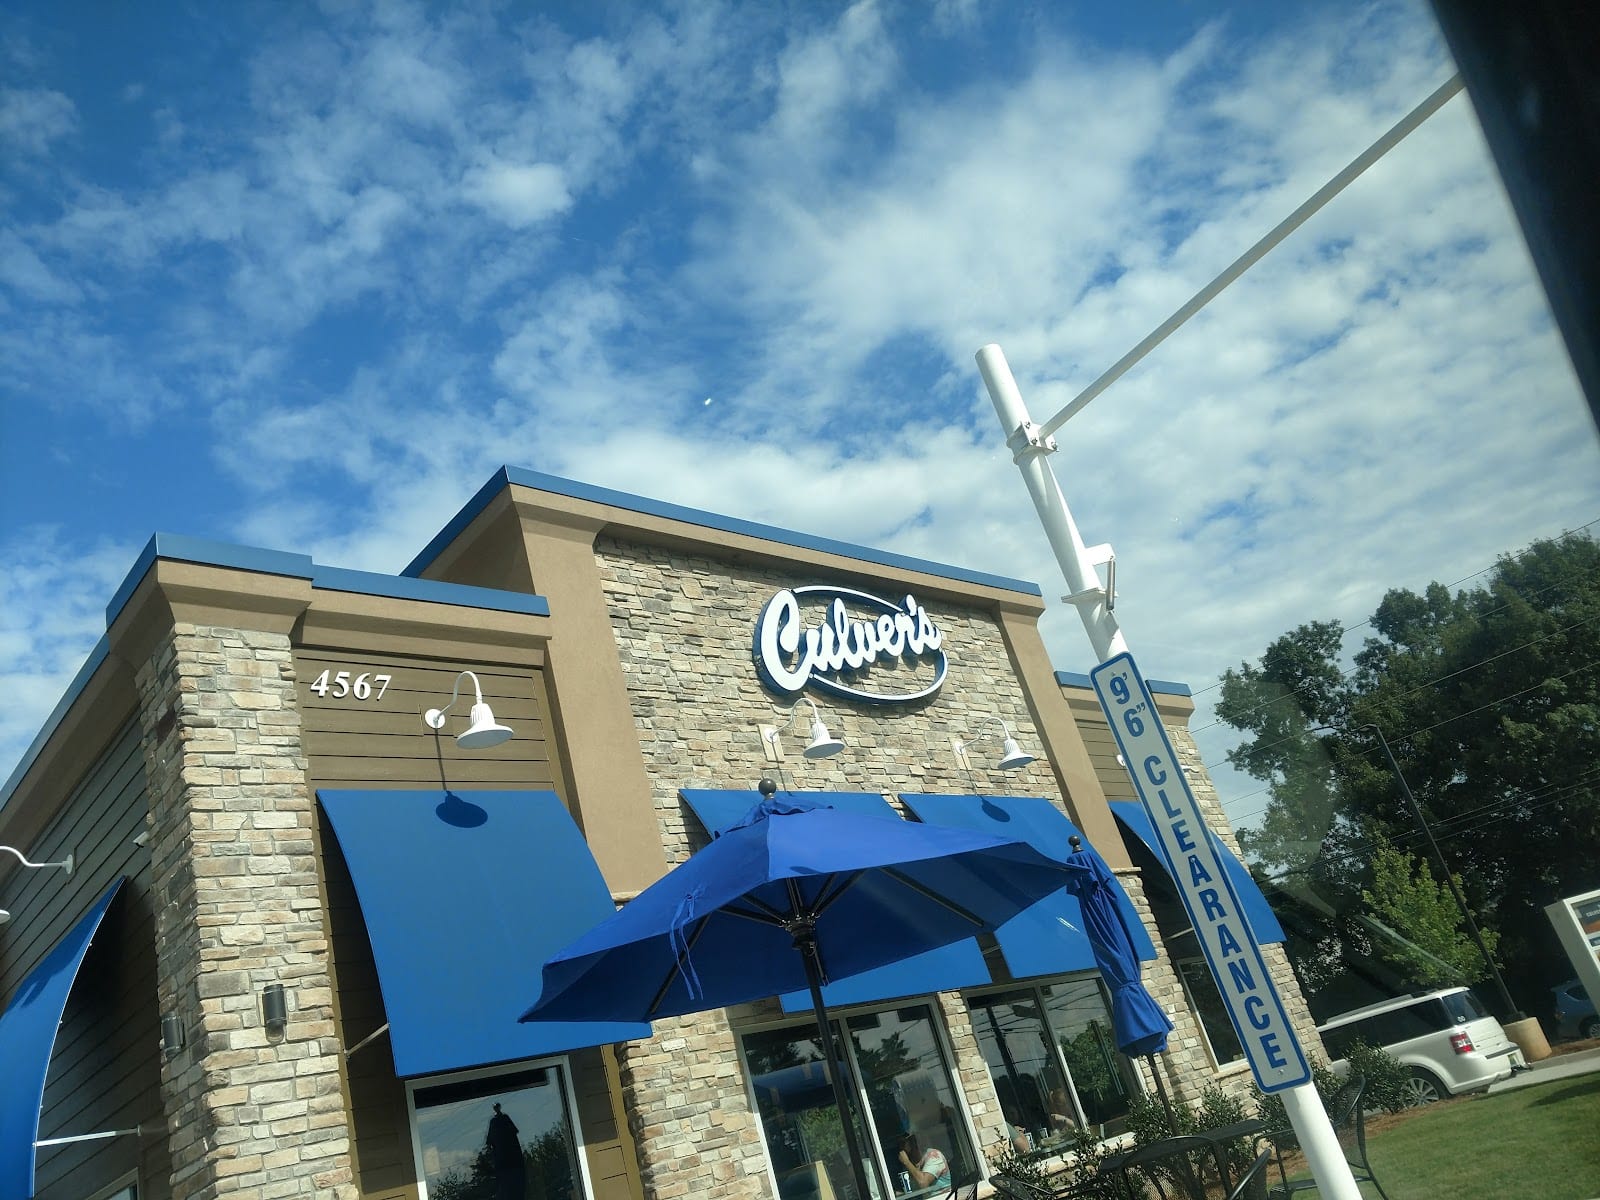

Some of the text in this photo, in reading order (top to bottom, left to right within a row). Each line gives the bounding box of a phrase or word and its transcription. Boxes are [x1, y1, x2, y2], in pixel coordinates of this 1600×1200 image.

[310, 669, 392, 700] 4567
[760, 588, 942, 691] Culver's
[1143, 755, 1288, 1069] CLEARANCE
